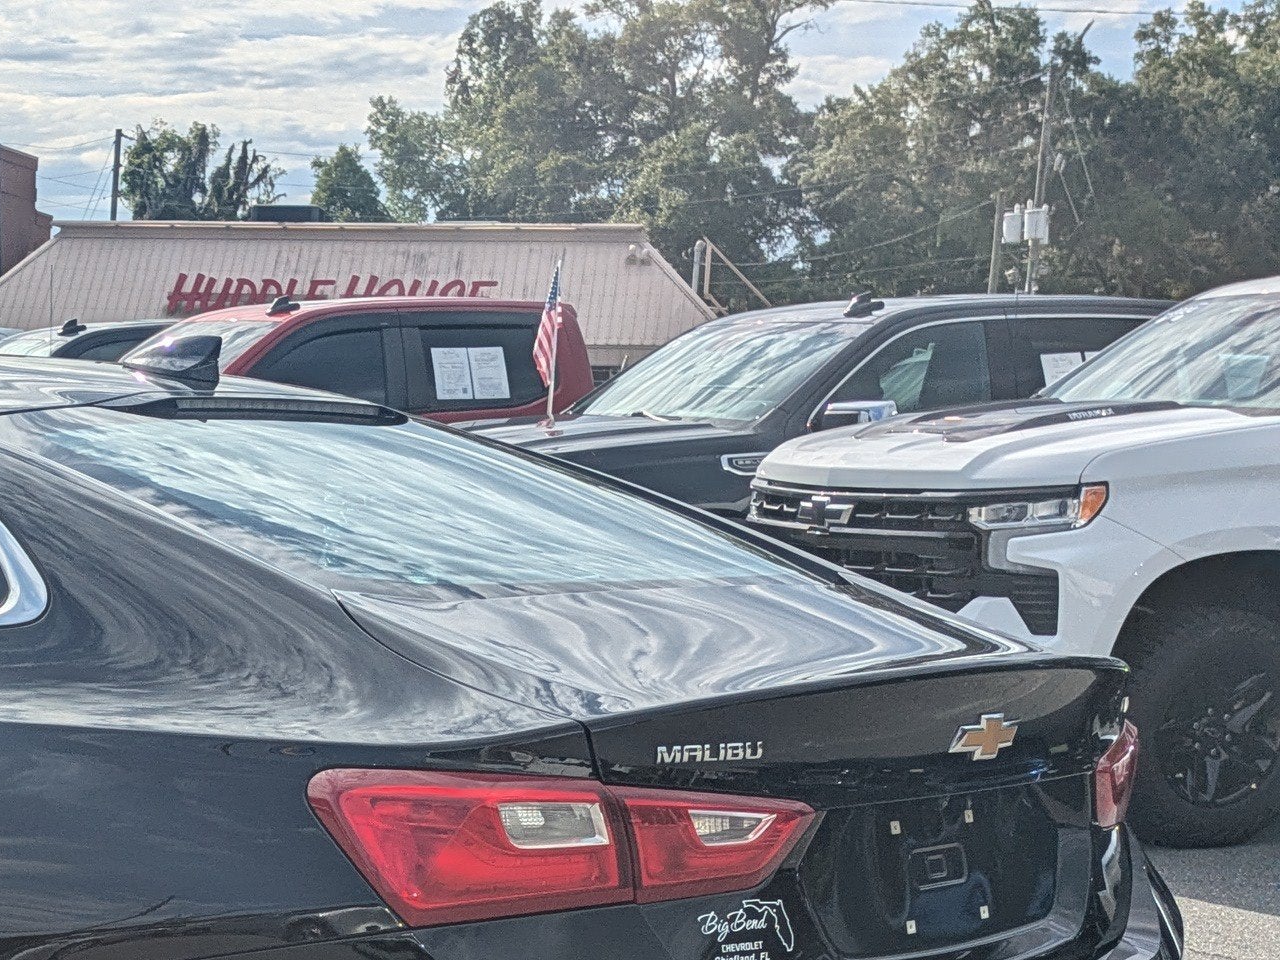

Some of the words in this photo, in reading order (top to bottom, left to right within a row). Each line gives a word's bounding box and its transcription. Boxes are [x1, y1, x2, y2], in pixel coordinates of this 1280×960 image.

[656, 741, 763, 764] MALIBU
[697, 911, 730, 942] Big
[726, 908, 768, 932] Bend
[721, 940, 764, 953] CHEVROLET
